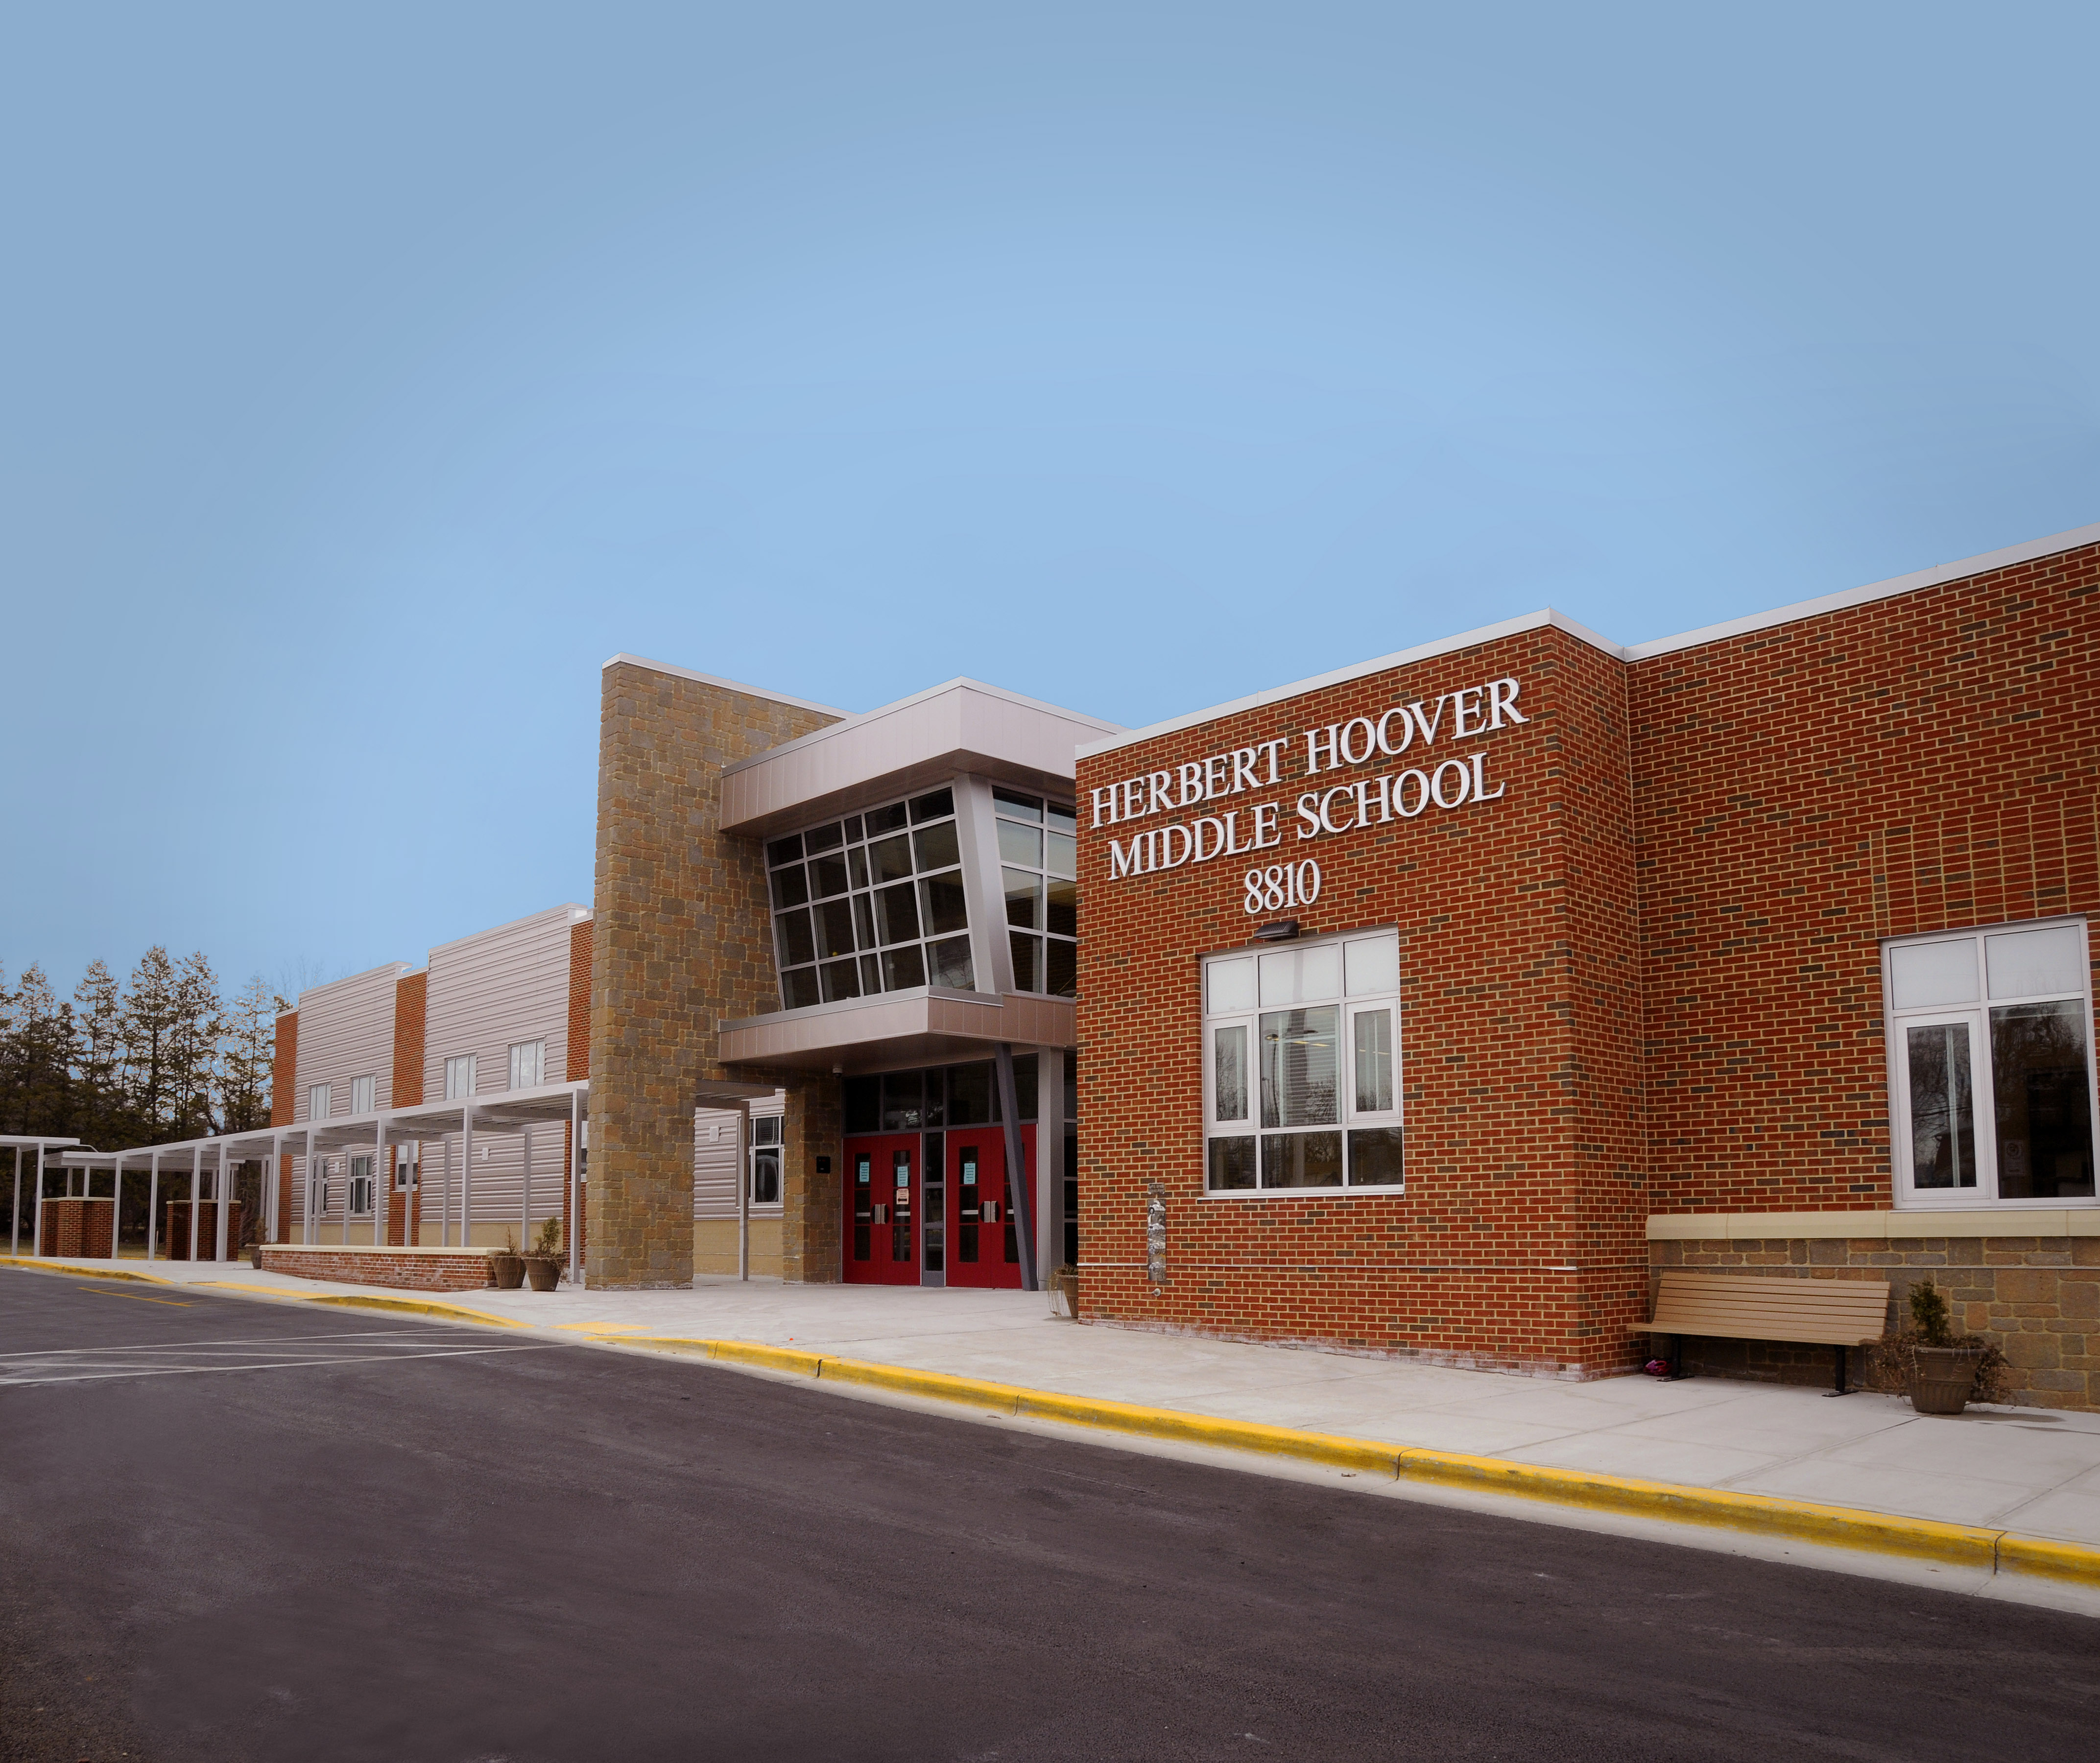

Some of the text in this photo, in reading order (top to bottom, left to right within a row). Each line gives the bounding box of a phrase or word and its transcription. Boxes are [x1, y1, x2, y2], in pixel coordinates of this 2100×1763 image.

[1089, 677, 1530, 829] HERBERT HOOVER
[1107, 752, 1505, 881] MIDDLE SCHOOL
[1244, 858, 1321, 914] 8810
